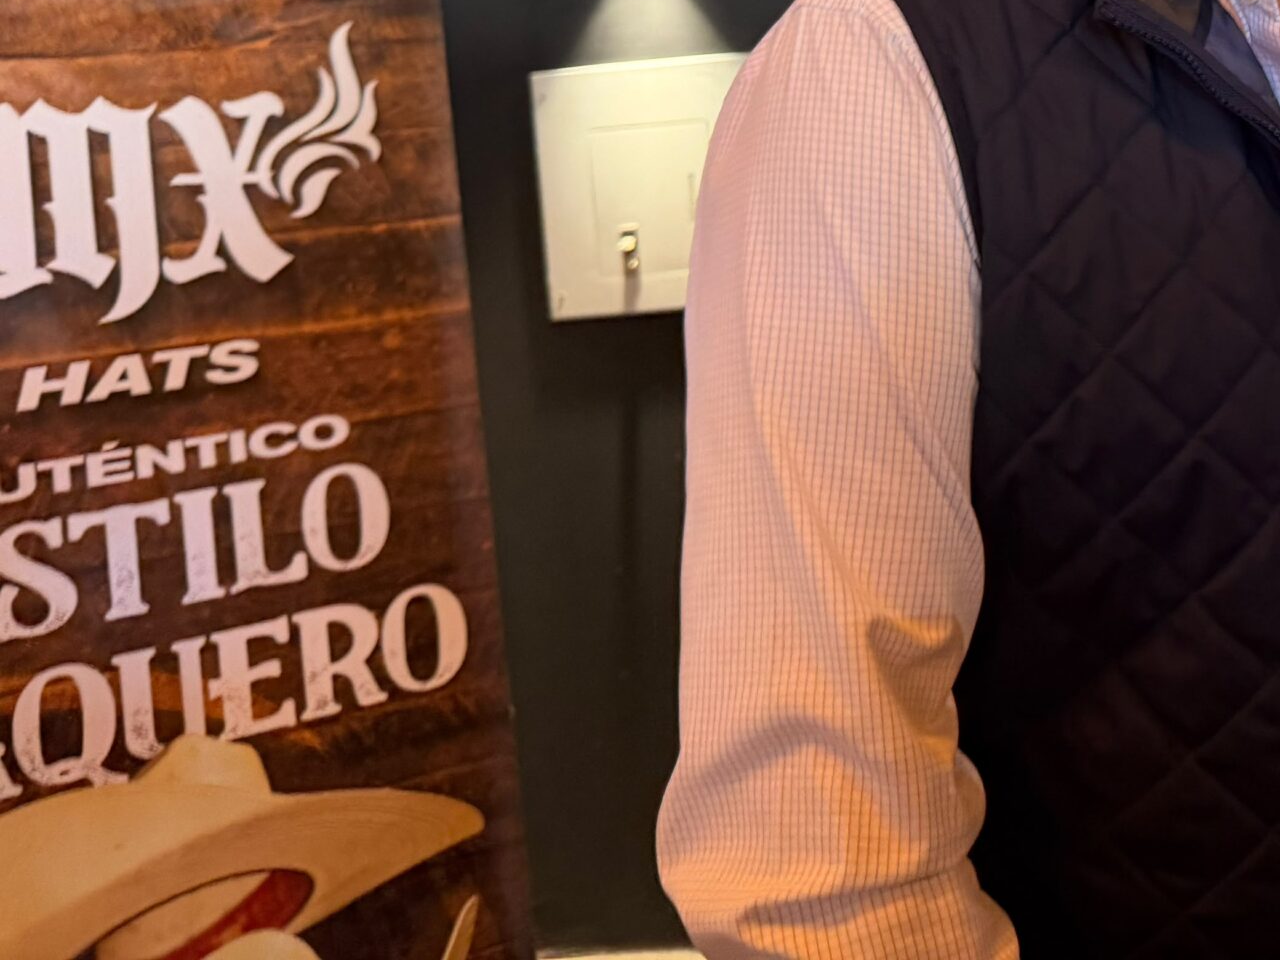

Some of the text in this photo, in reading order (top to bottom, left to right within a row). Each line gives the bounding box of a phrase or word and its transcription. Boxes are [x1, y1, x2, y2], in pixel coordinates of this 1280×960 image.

[16, 339, 260, 413] HATS
[0, 462, 391, 641] STILO
[0, 583, 468, 802] QUERO
